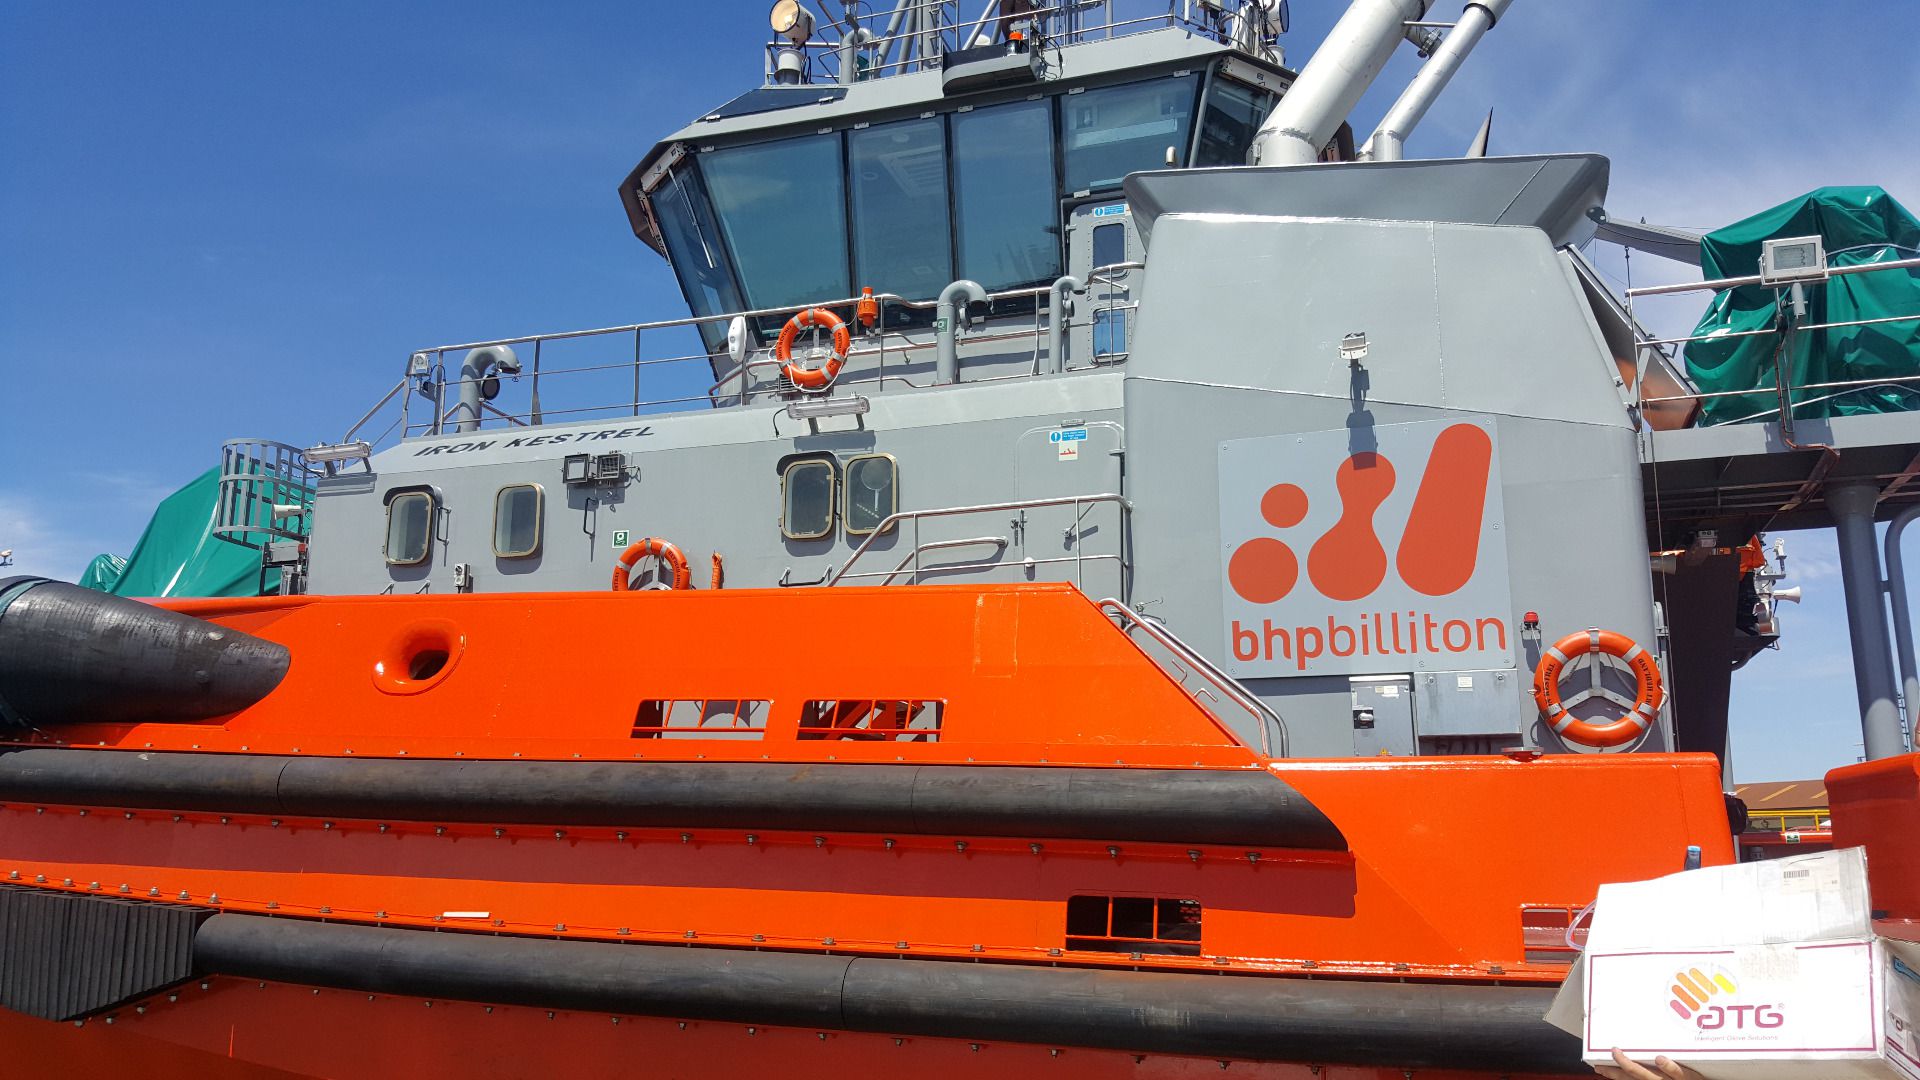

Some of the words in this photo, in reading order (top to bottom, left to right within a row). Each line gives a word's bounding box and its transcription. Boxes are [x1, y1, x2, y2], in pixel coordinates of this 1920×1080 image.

[413, 440, 498, 456] IRON
[503, 426, 655, 448] KESTREL
[1231, 610, 1506, 670] bhpbilliton
